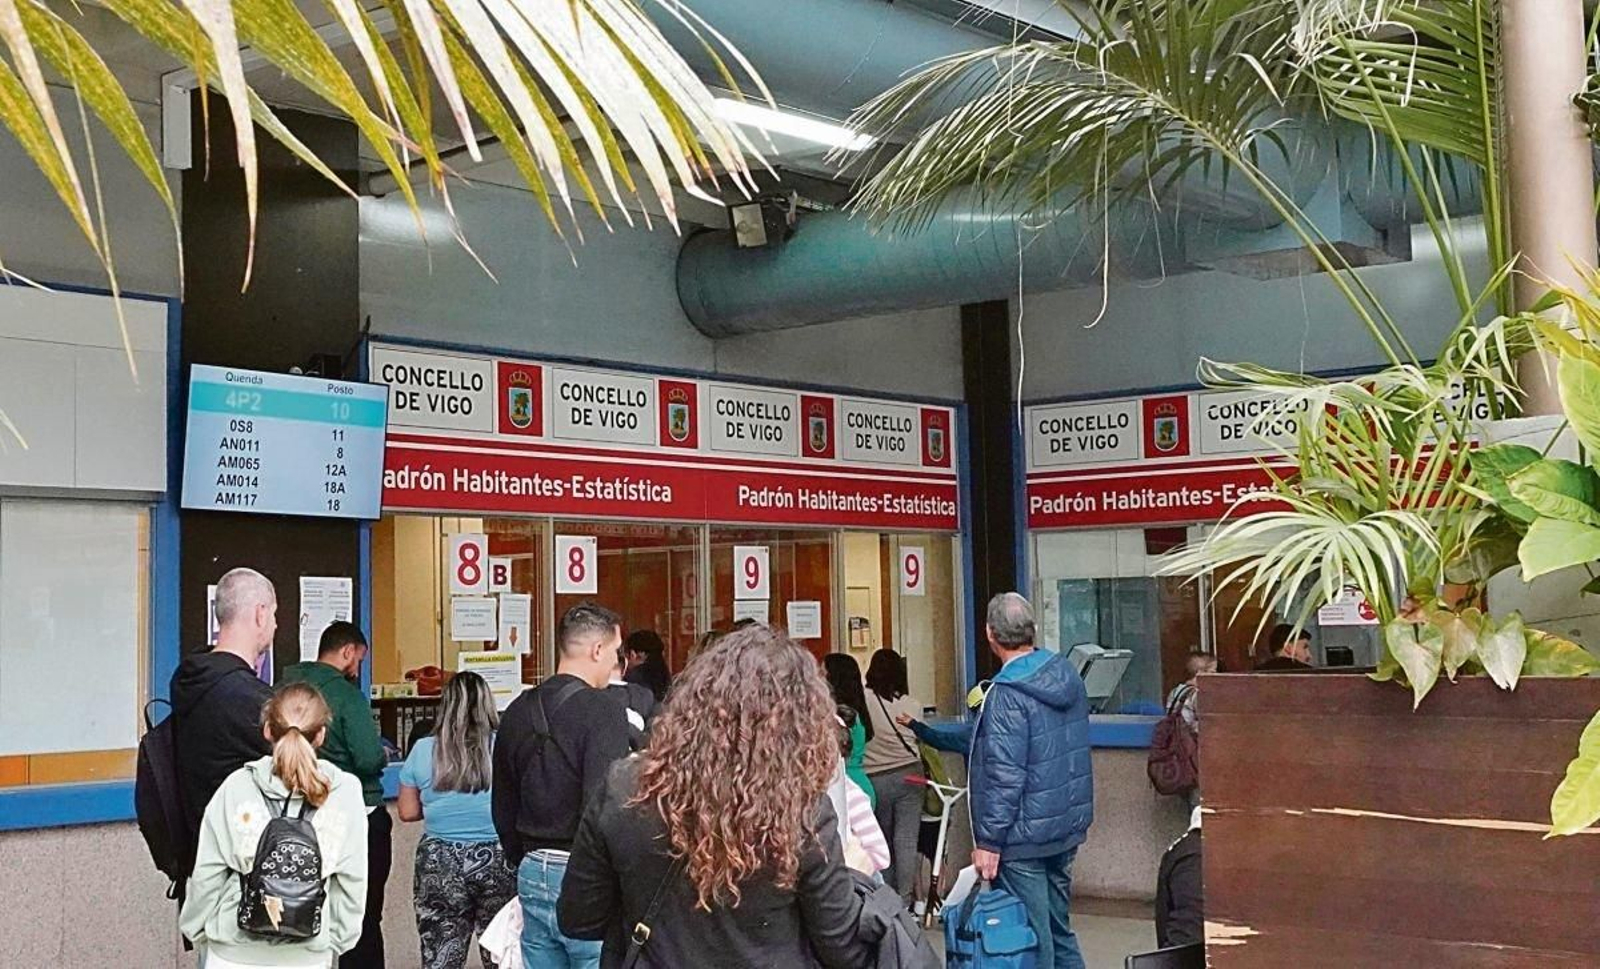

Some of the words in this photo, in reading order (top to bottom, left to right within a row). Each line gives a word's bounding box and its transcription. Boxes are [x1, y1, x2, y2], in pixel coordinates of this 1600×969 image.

[225, 371, 263, 385] Quenda
[327, 384, 353, 395] Posto
[382, 364, 484, 392] CONCELLO
[225, 391, 262, 411] 4P2
[330, 402, 350, 420] 10
[395, 391, 420, 410] DE
[428, 394, 472, 415] VIGO
[560, 382, 647, 408] CONCELLO
[571, 408, 592, 426] DE
[599, 410, 638, 430] VIGO
[716, 399, 791, 422] CONCELLO
[726, 422, 744, 439] DE
[749, 424, 783, 442] VIGO
[847, 412, 912, 433] CONCELLO
[1040, 412, 1129, 434] CONCELLO
[1221, 424, 1243, 440] DE
[332, 429, 344, 441] 11
[856, 433, 872, 449] DE
[876, 436, 906, 452] VIGO
[1050, 437, 1072, 453] DE
[1078, 434, 1119, 450] VIGO
[219, 437, 260, 452] AN011
[336, 447, 345, 460] 8
[217, 456, 260, 471] AM065
[325, 464, 347, 477] 12A
[216, 474, 258, 488] AM014
[325, 482, 345, 494] 18A
[384, 464, 446, 491] adrón
[453, 468, 672, 502] Habitantes-Estatística
[215, 492, 257, 506] AM117
[327, 499, 340, 511] 18
[738, 485, 793, 508] Padrón
[798, 489, 956, 516] Habitantes-Estatística
[1030, 492, 1096, 514] Padrón
[457, 543, 481, 586] 8
[493, 565, 507, 585] B
[568, 547, 585, 582] 8
[745, 556, 759, 589] 9
[905, 554, 919, 588] 9
